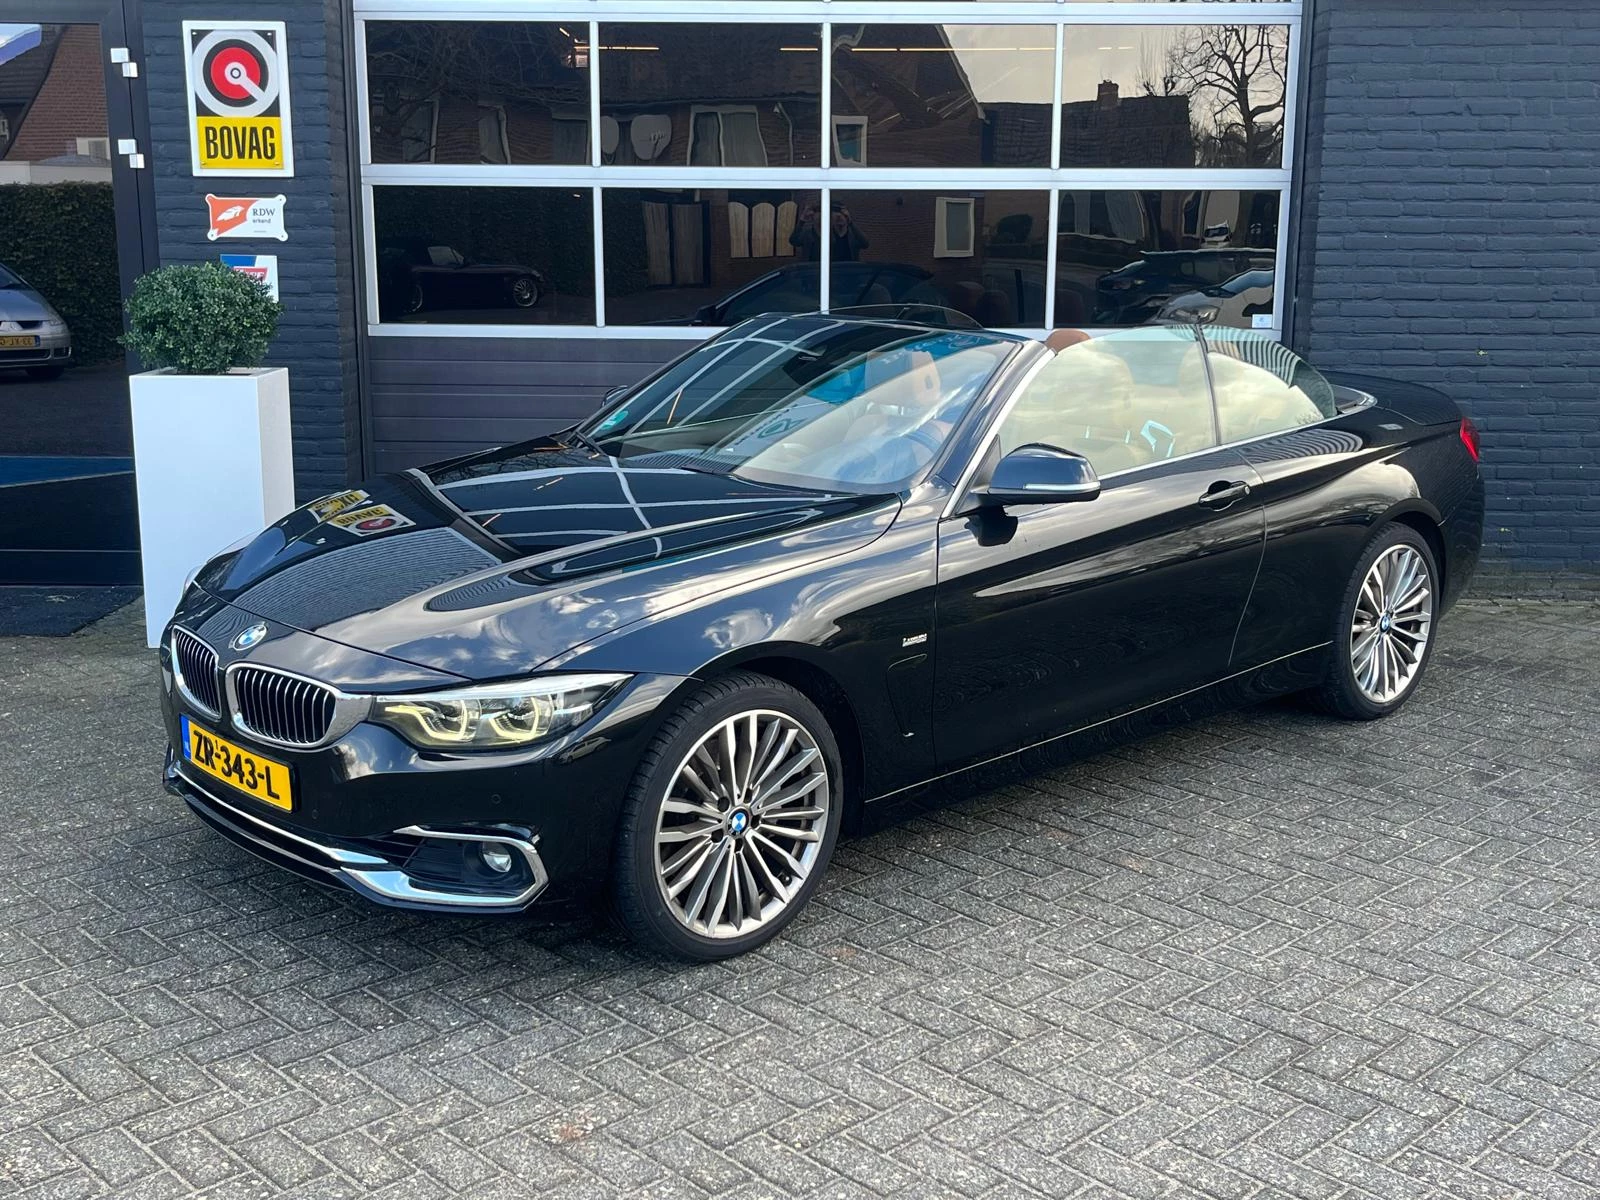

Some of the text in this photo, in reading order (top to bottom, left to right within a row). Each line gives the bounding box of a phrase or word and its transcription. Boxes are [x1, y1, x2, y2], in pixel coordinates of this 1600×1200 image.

[204, 125, 276, 160] BOVAG
[252, 208, 275, 217] RDW
[193, 729, 280, 800] ZR-343-L
